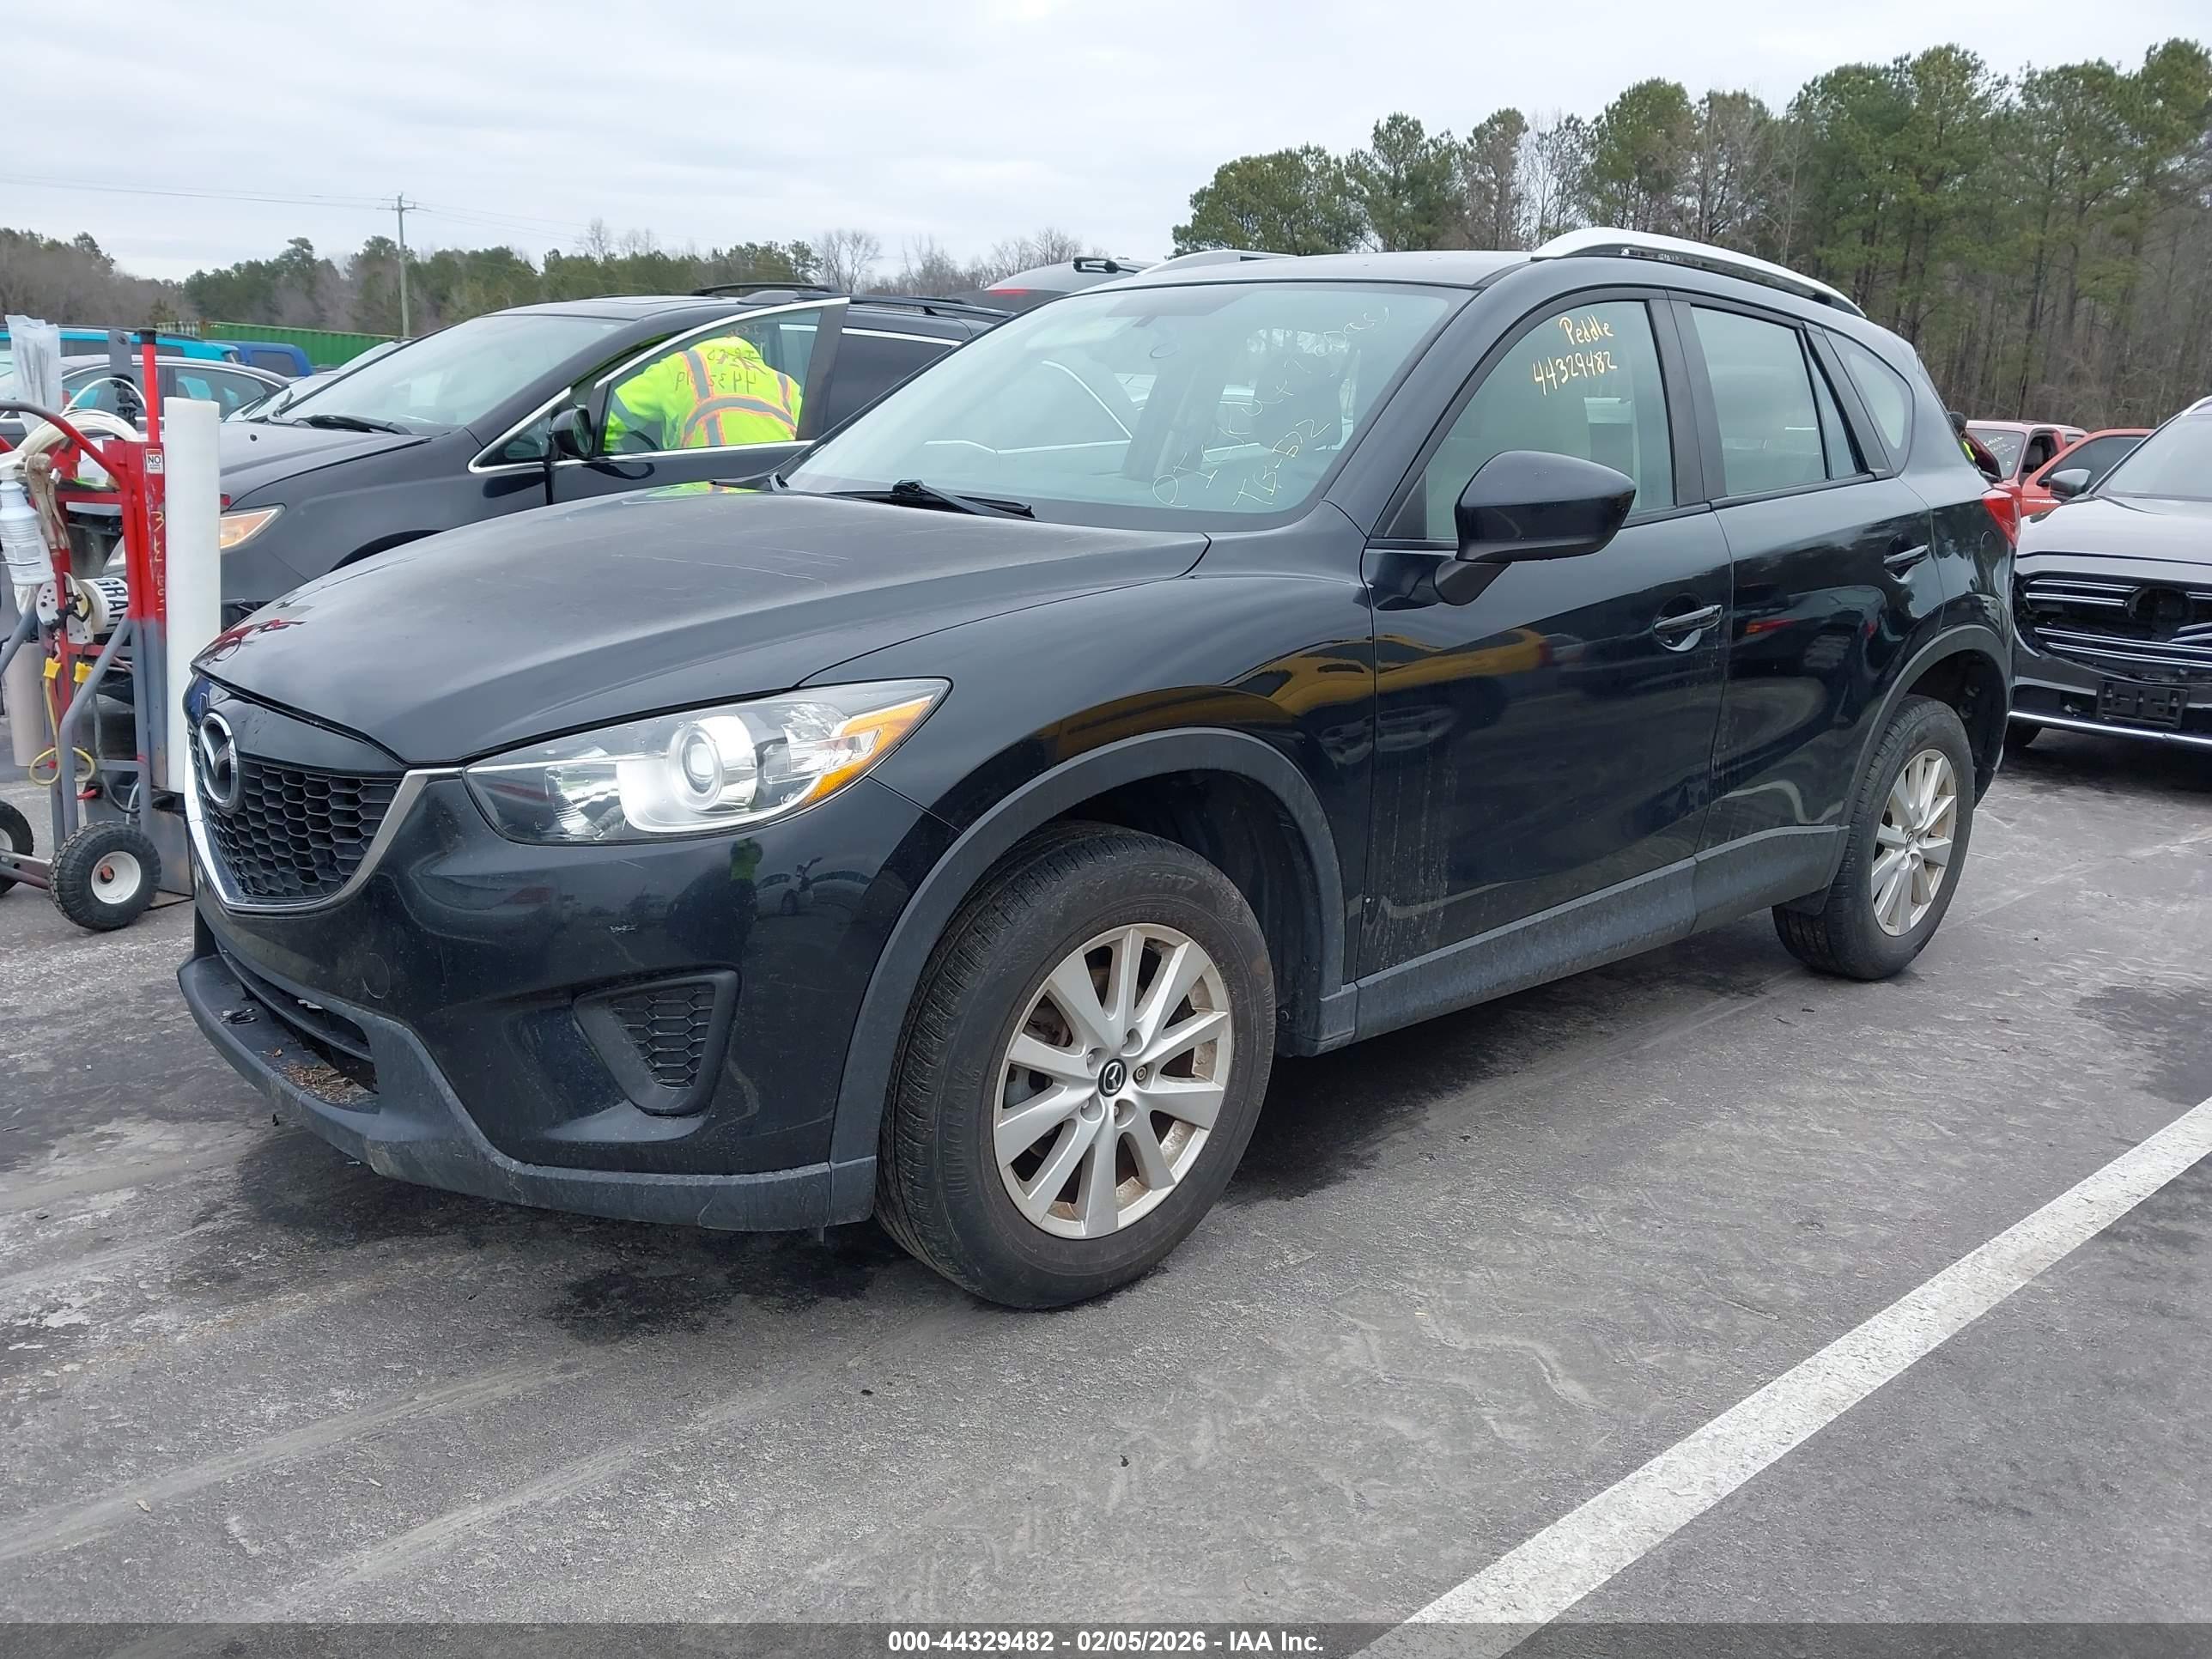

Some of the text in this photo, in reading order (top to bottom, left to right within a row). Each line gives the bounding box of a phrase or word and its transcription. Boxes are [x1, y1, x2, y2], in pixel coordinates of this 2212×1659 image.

[1559, 313, 1615, 345] Peddle
[1532, 349, 1618, 396] 44329482
[148, 455, 161, 465] NO
